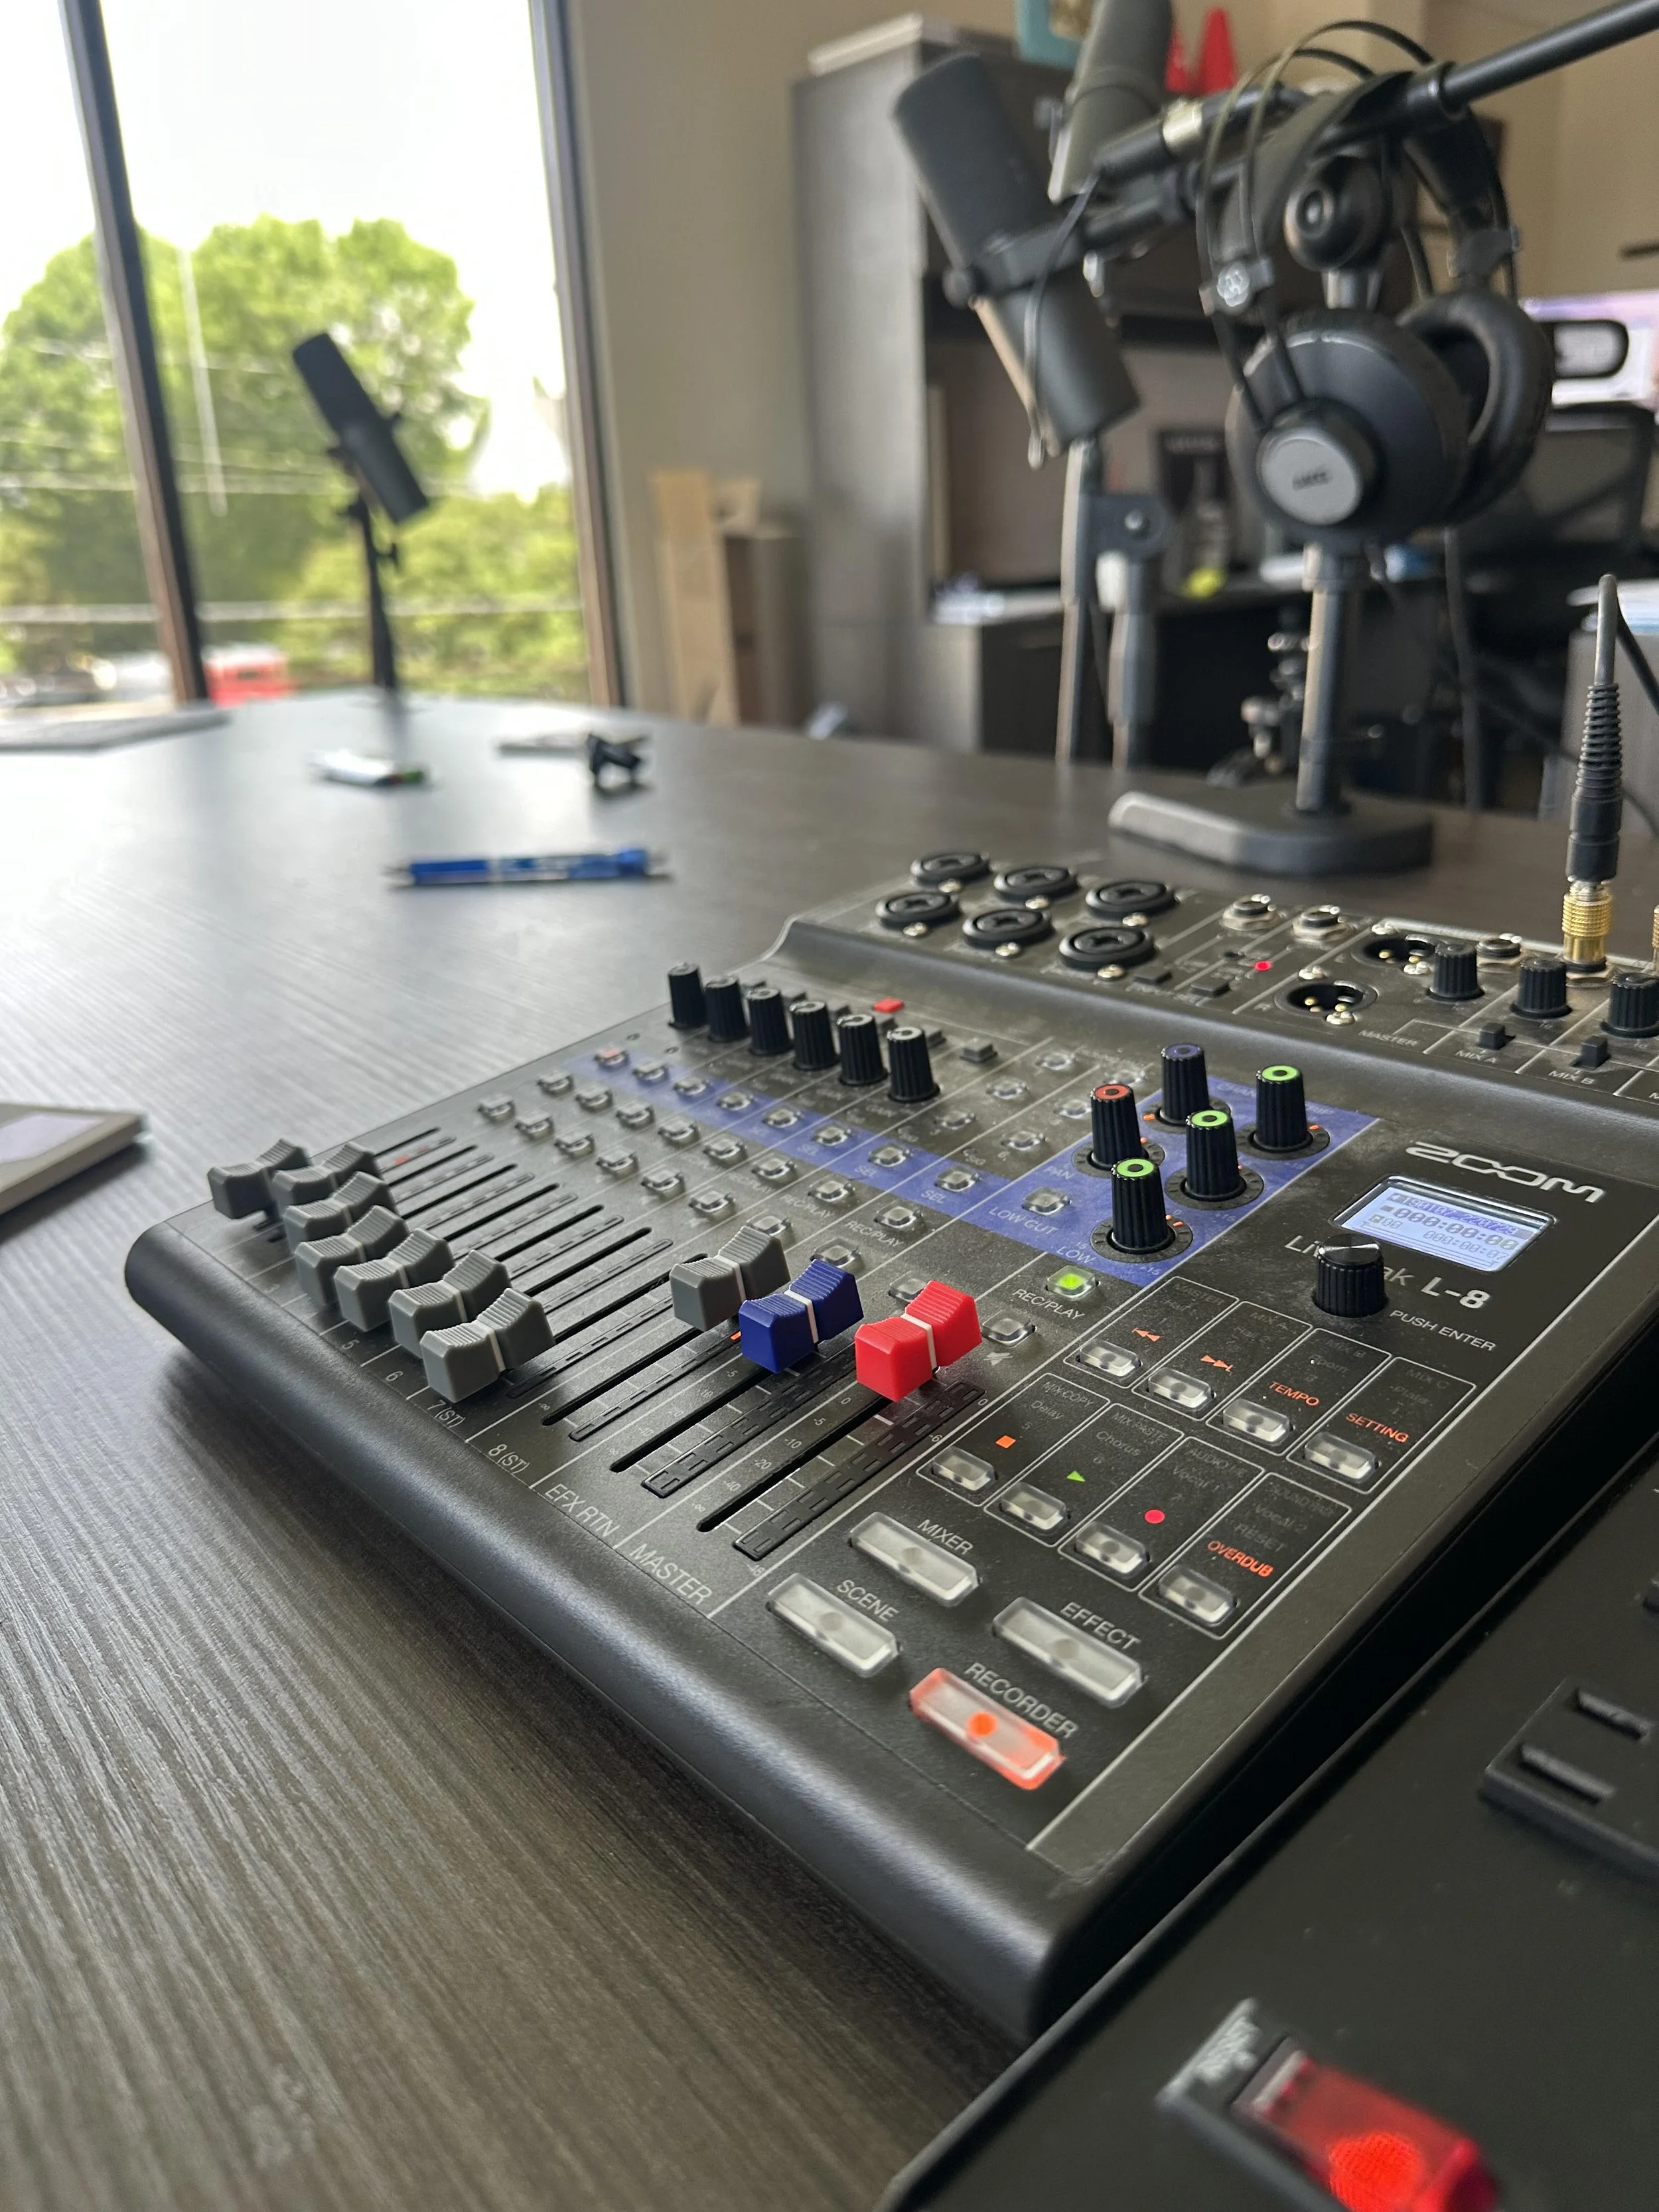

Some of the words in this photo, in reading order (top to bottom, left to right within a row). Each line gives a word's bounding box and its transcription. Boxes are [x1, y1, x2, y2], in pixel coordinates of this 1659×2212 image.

[1548, 1070, 1579, 1082] MIX
[921, 1190, 946, 1203] SEL
[845, 1220, 904, 1247] REC/PLAY
[989, 1207, 1024, 1223] LOW
[1024, 1220, 1058, 1234] CUT
[1394, 1208, 1519, 1250] 000:00:00
[1056, 1246, 1096, 1264] LOW
[1012, 1288, 1086, 1319] REC/PLAY
[1421, 1277, 1490, 1309] L-8
[1390, 1309, 1439, 1331] PUSH
[1438, 1325, 1496, 1351] ENTER
[342, 1339, 360, 1350] 5
[386, 1370, 403, 1381] 6
[427, 1400, 446, 1410] 7
[1042, 1381, 1063, 1394] MIX
[1062, 1390, 1094, 1408] COPY
[1268, 1380, 1320, 1406] TEMPO
[813, 1417, 826, 1426] -5
[1031, 1400, 1064, 1420] Delay
[1346, 1412, 1409, 1443] SETTING
[784, 1438, 802, 1449] -10
[1096, 1430, 1141, 1456] Chorus
[488, 1444, 507, 1456] 8
[498, 1451, 530, 1474] (ST)
[755, 1458, 772, 1469] -20
[544, 1483, 584, 1513] EFX
[576, 1505, 620, 1538] RTN
[916, 1518, 974, 1556] MIXER
[1207, 1540, 1274, 1578] OVERDUB
[628, 1543, 713, 1605] MASTER
[836, 1578, 900, 1623] SCENE
[1060, 1601, 1141, 1651] EFFECT
[964, 1662, 1079, 1739] RECORDER
